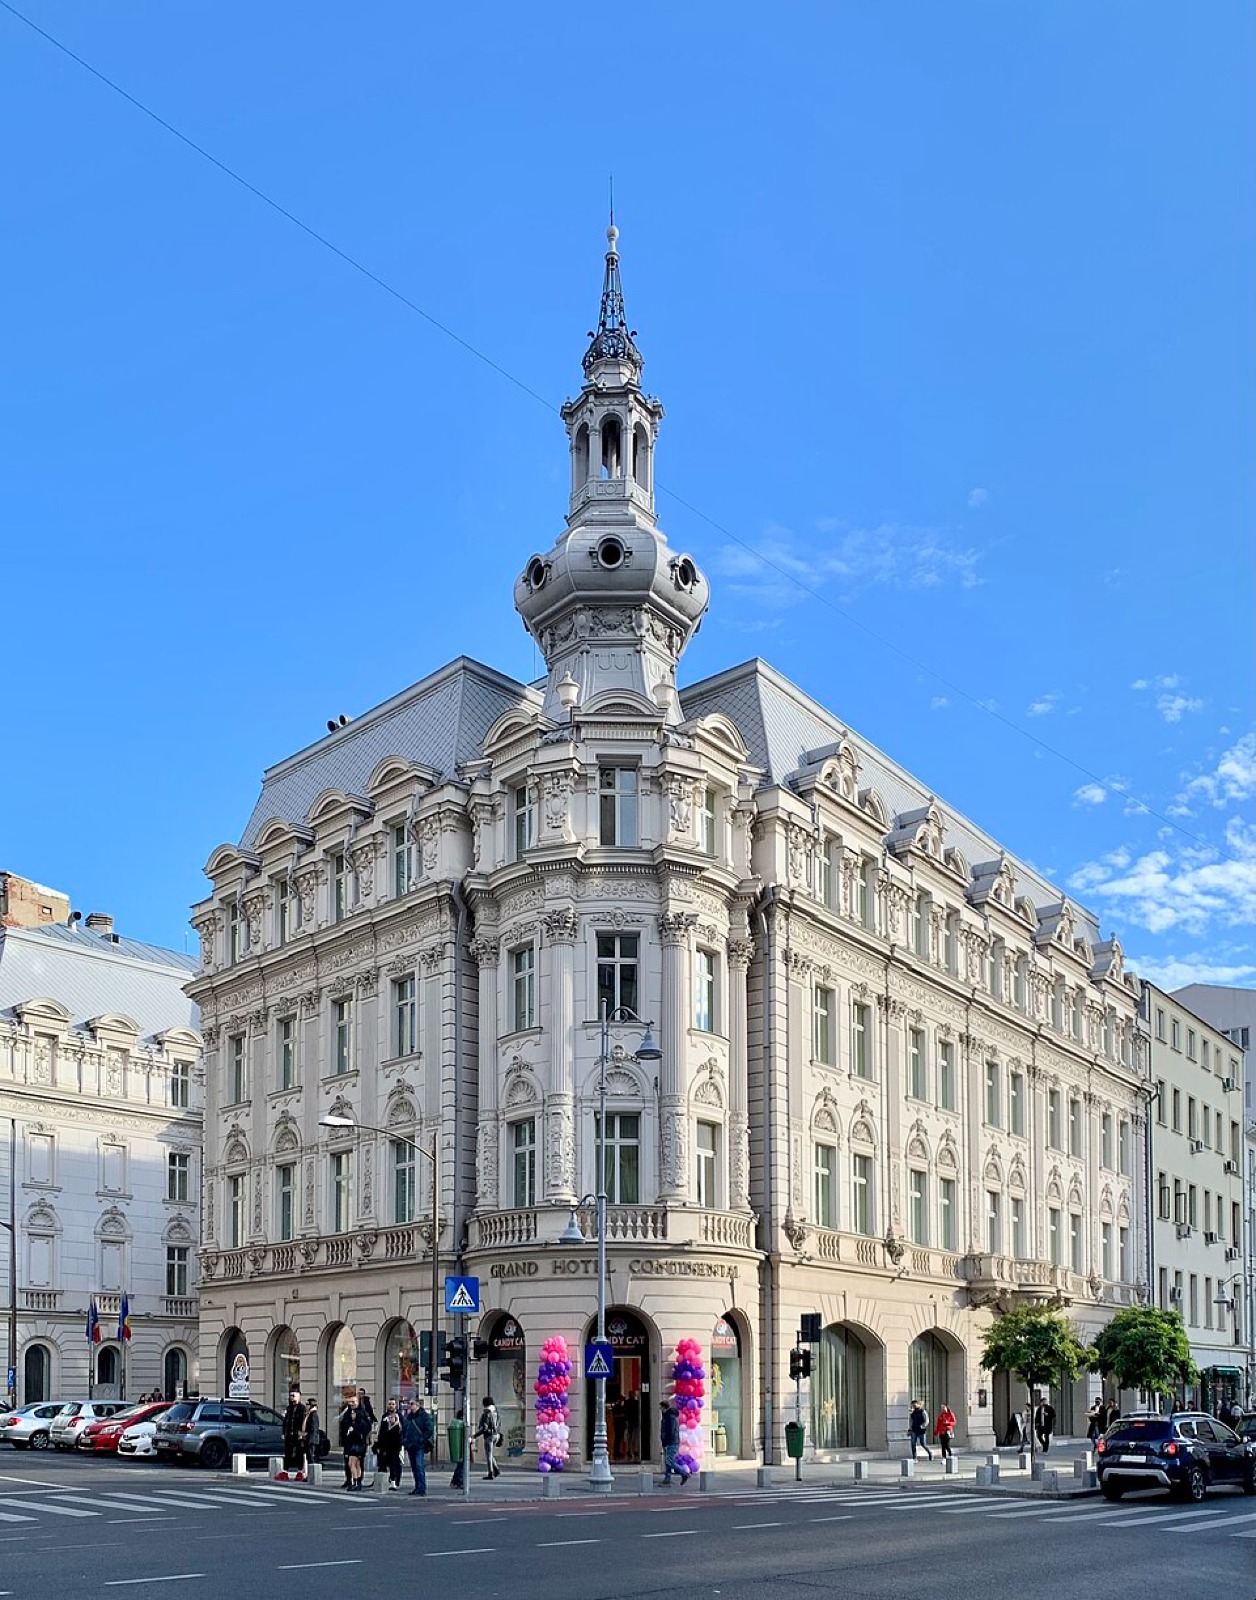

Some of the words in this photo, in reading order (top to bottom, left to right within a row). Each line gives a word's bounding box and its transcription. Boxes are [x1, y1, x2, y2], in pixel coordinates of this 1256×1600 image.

[490, 1260, 539, 1279] GRAND
[628, 1259, 740, 1279] CONTINENTAL
[493, 1337, 515, 1347] CANDY
[515, 1336, 524, 1346] CA
[590, 1336, 624, 1345] CNDY
[626, 1336, 645, 1345] CAT
